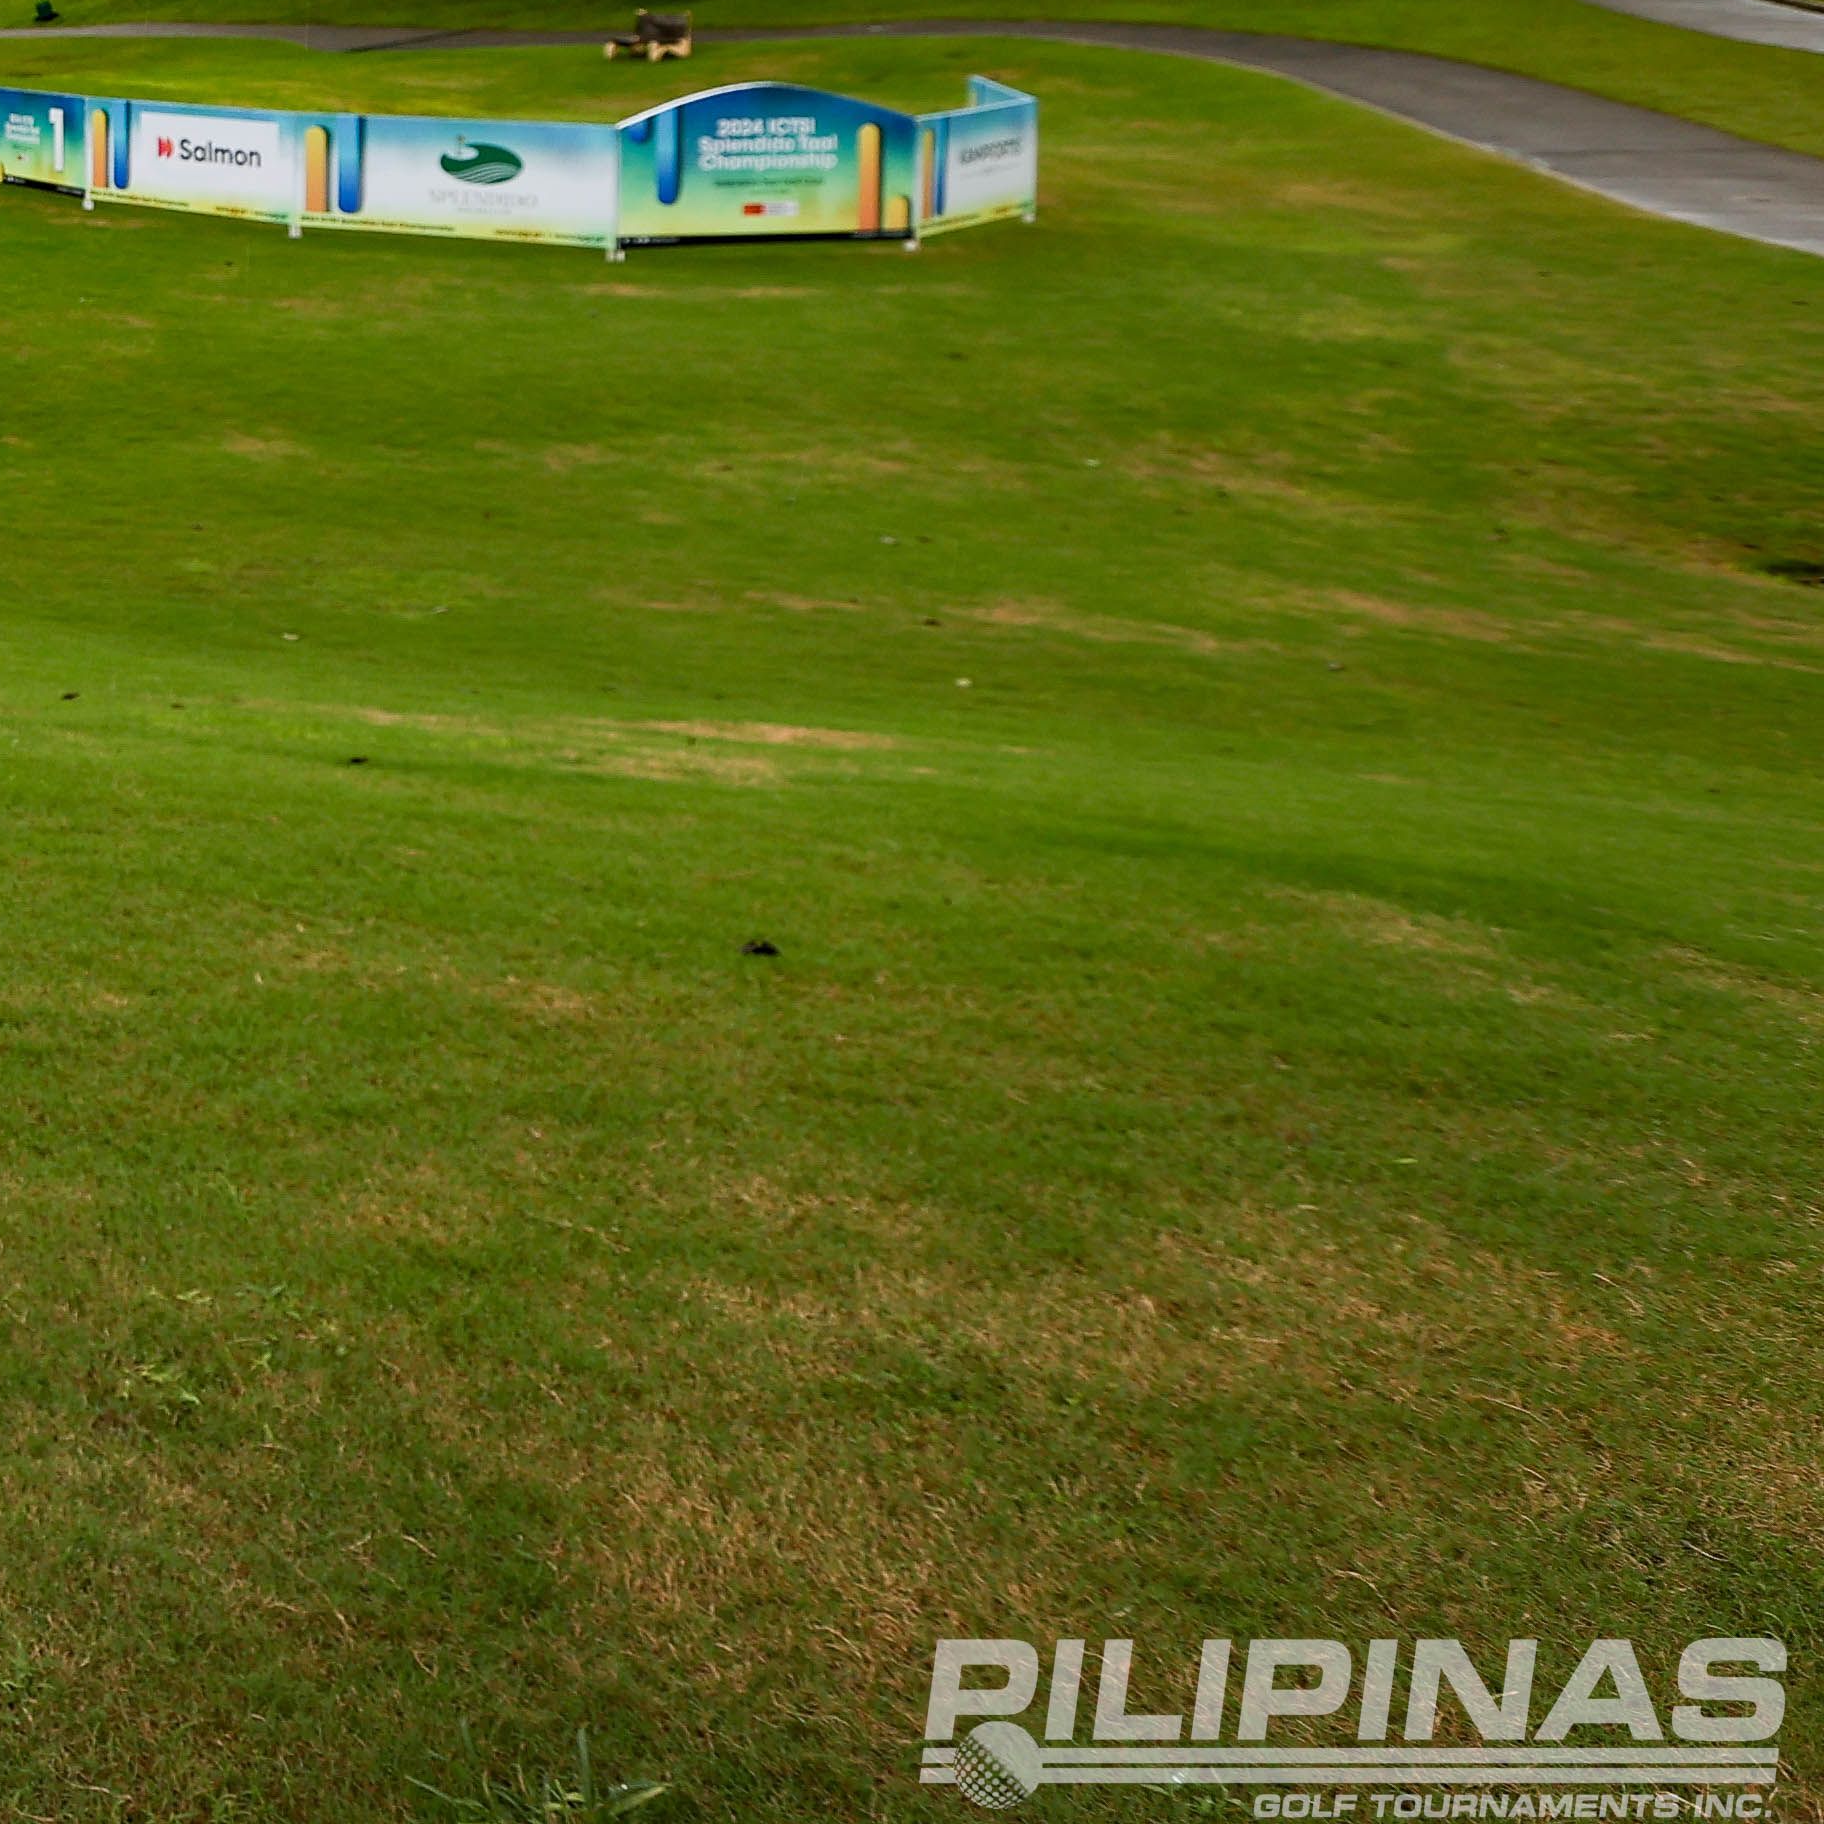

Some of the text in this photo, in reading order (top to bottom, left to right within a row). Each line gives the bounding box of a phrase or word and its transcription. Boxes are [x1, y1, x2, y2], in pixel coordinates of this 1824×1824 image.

[715, 116, 817, 137] 2024 ICTSI
[179, 138, 262, 168] Salmon
[698, 152, 839, 172] Championship
